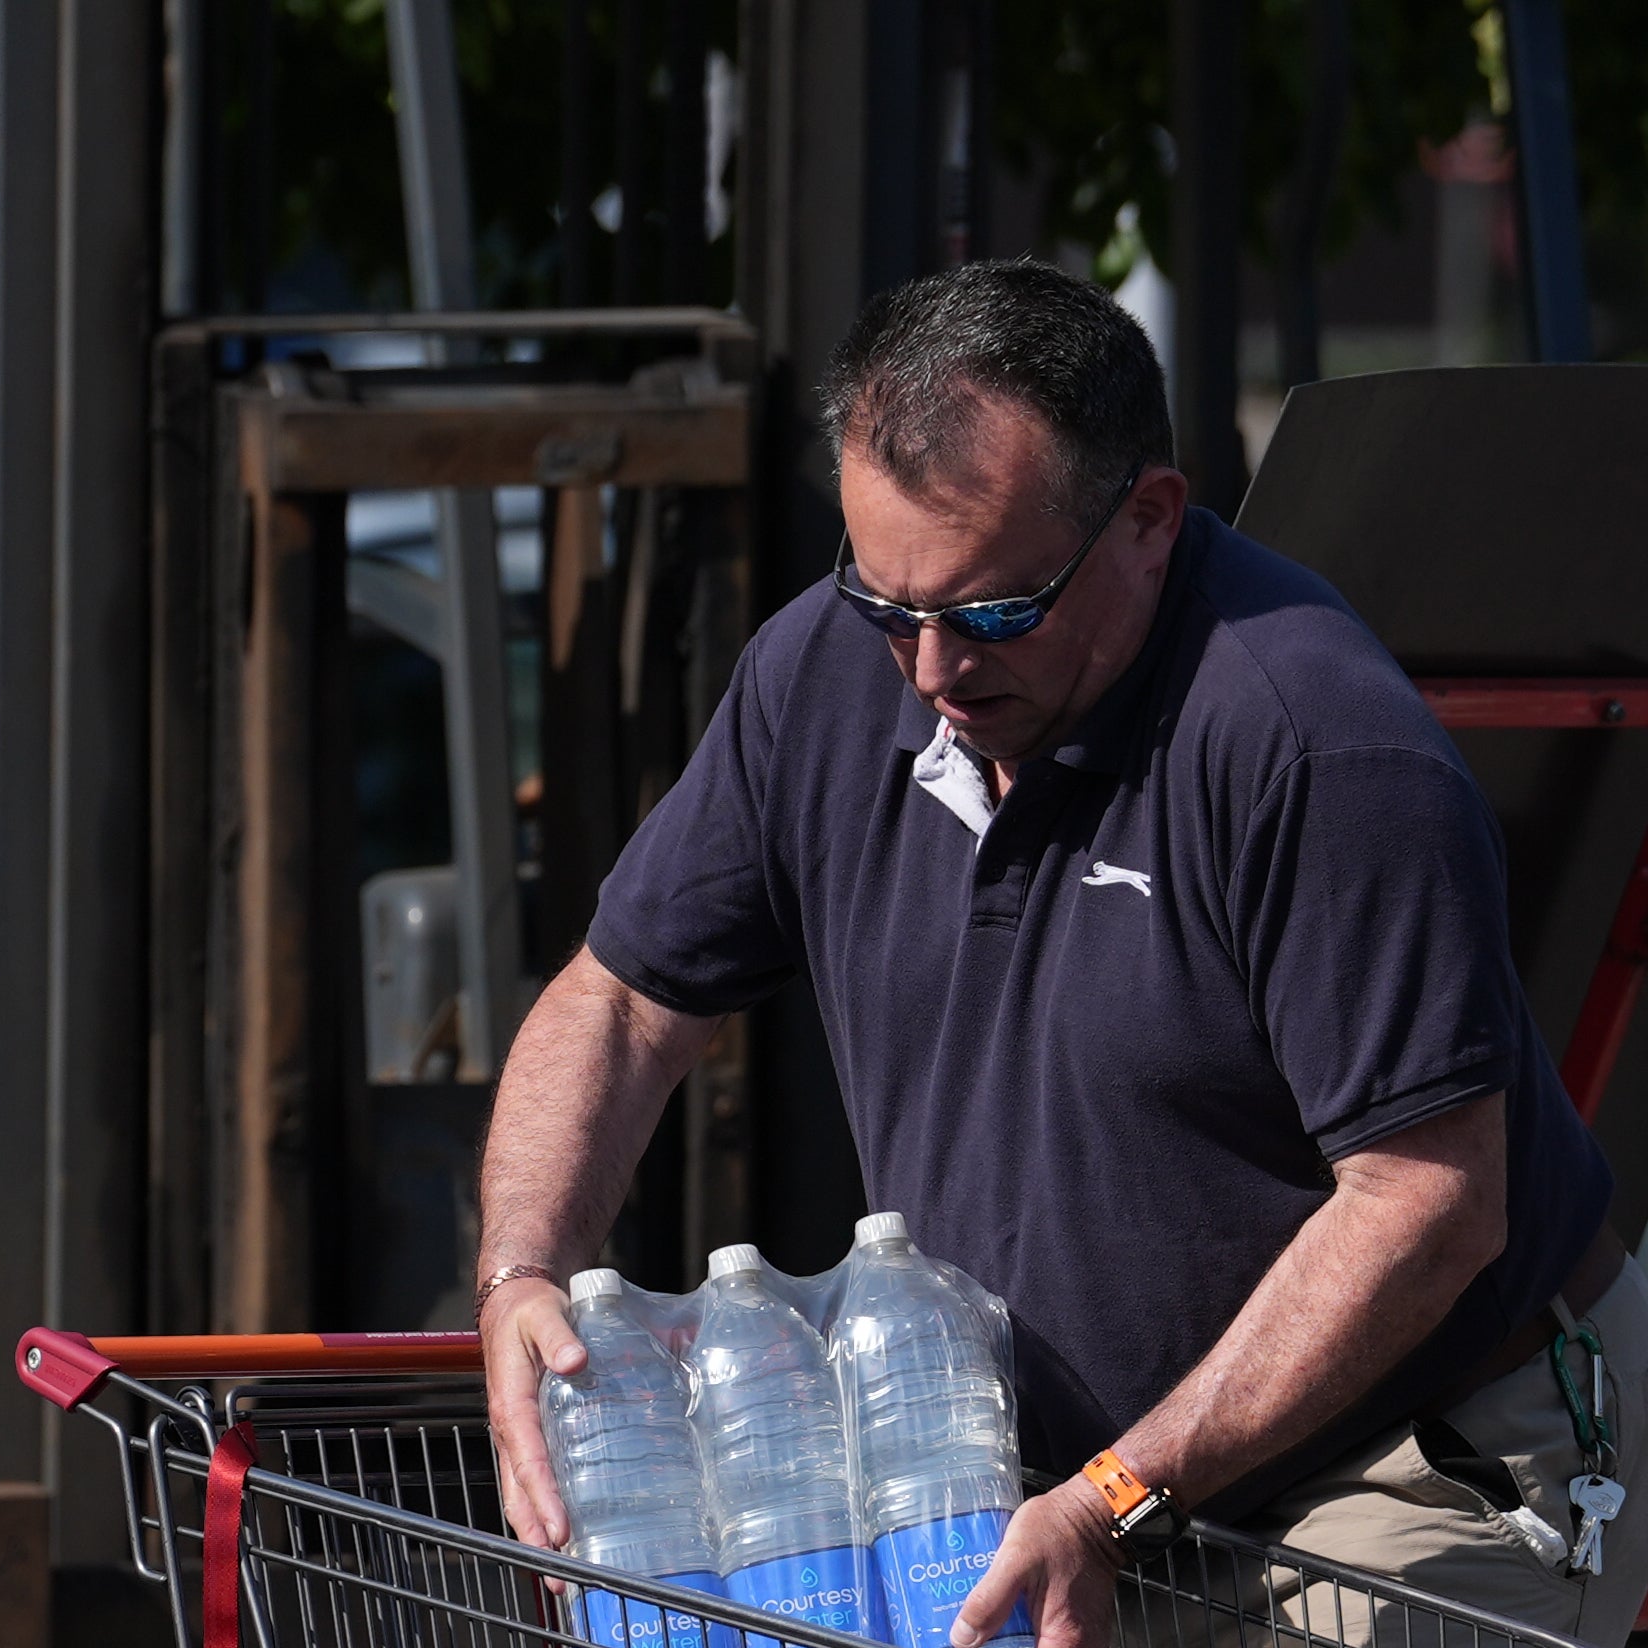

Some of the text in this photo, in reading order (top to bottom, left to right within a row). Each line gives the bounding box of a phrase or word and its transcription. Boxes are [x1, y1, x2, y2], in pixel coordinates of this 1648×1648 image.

[908, 1550, 999, 1583] Courtes
[928, 1574, 985, 1599] Wat
[761, 1587, 863, 1614] Courtesy
[801, 1609, 852, 1627] ater
